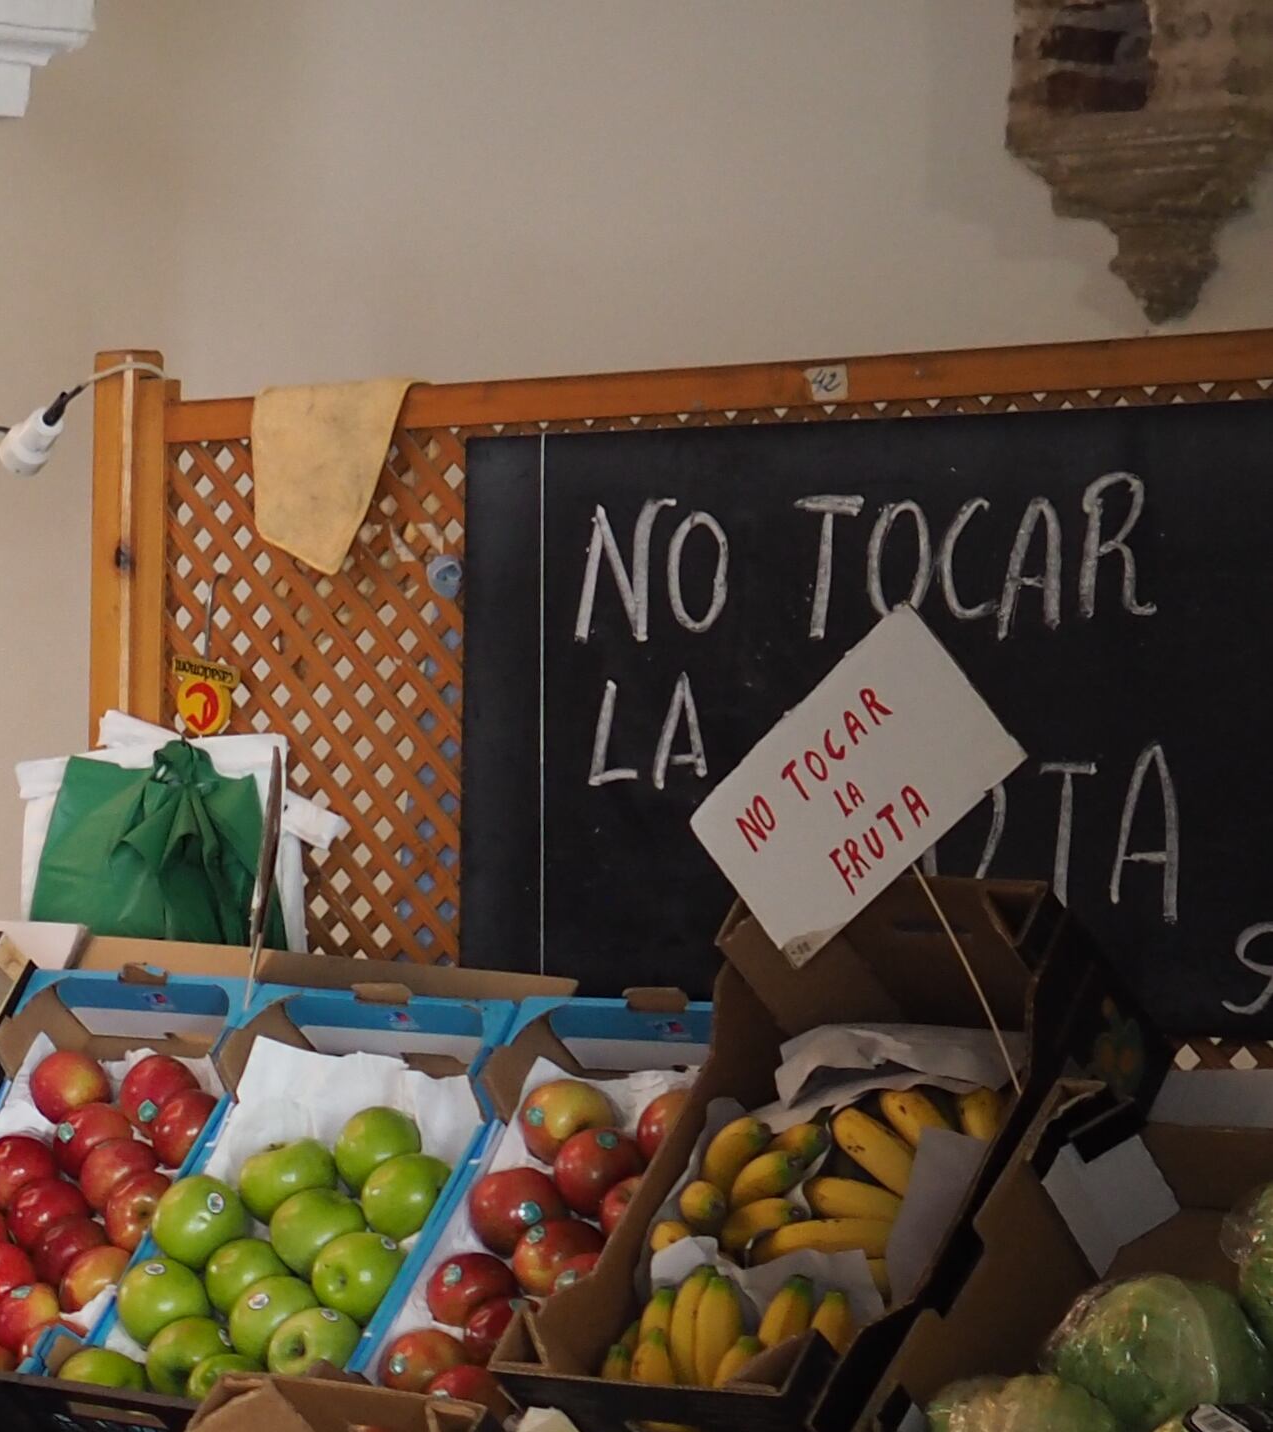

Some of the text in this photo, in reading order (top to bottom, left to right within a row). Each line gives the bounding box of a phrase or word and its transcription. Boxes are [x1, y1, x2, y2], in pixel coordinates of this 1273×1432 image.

[811, 368, 841, 393] 42
[574, 471, 1157, 642] NO TOCAR
[588, 671, 708, 789] LA
[735, 687, 894, 853] NO TOCAR
[828, 785, 931, 896] FRUTA
[832, 780, 866, 818] LA
